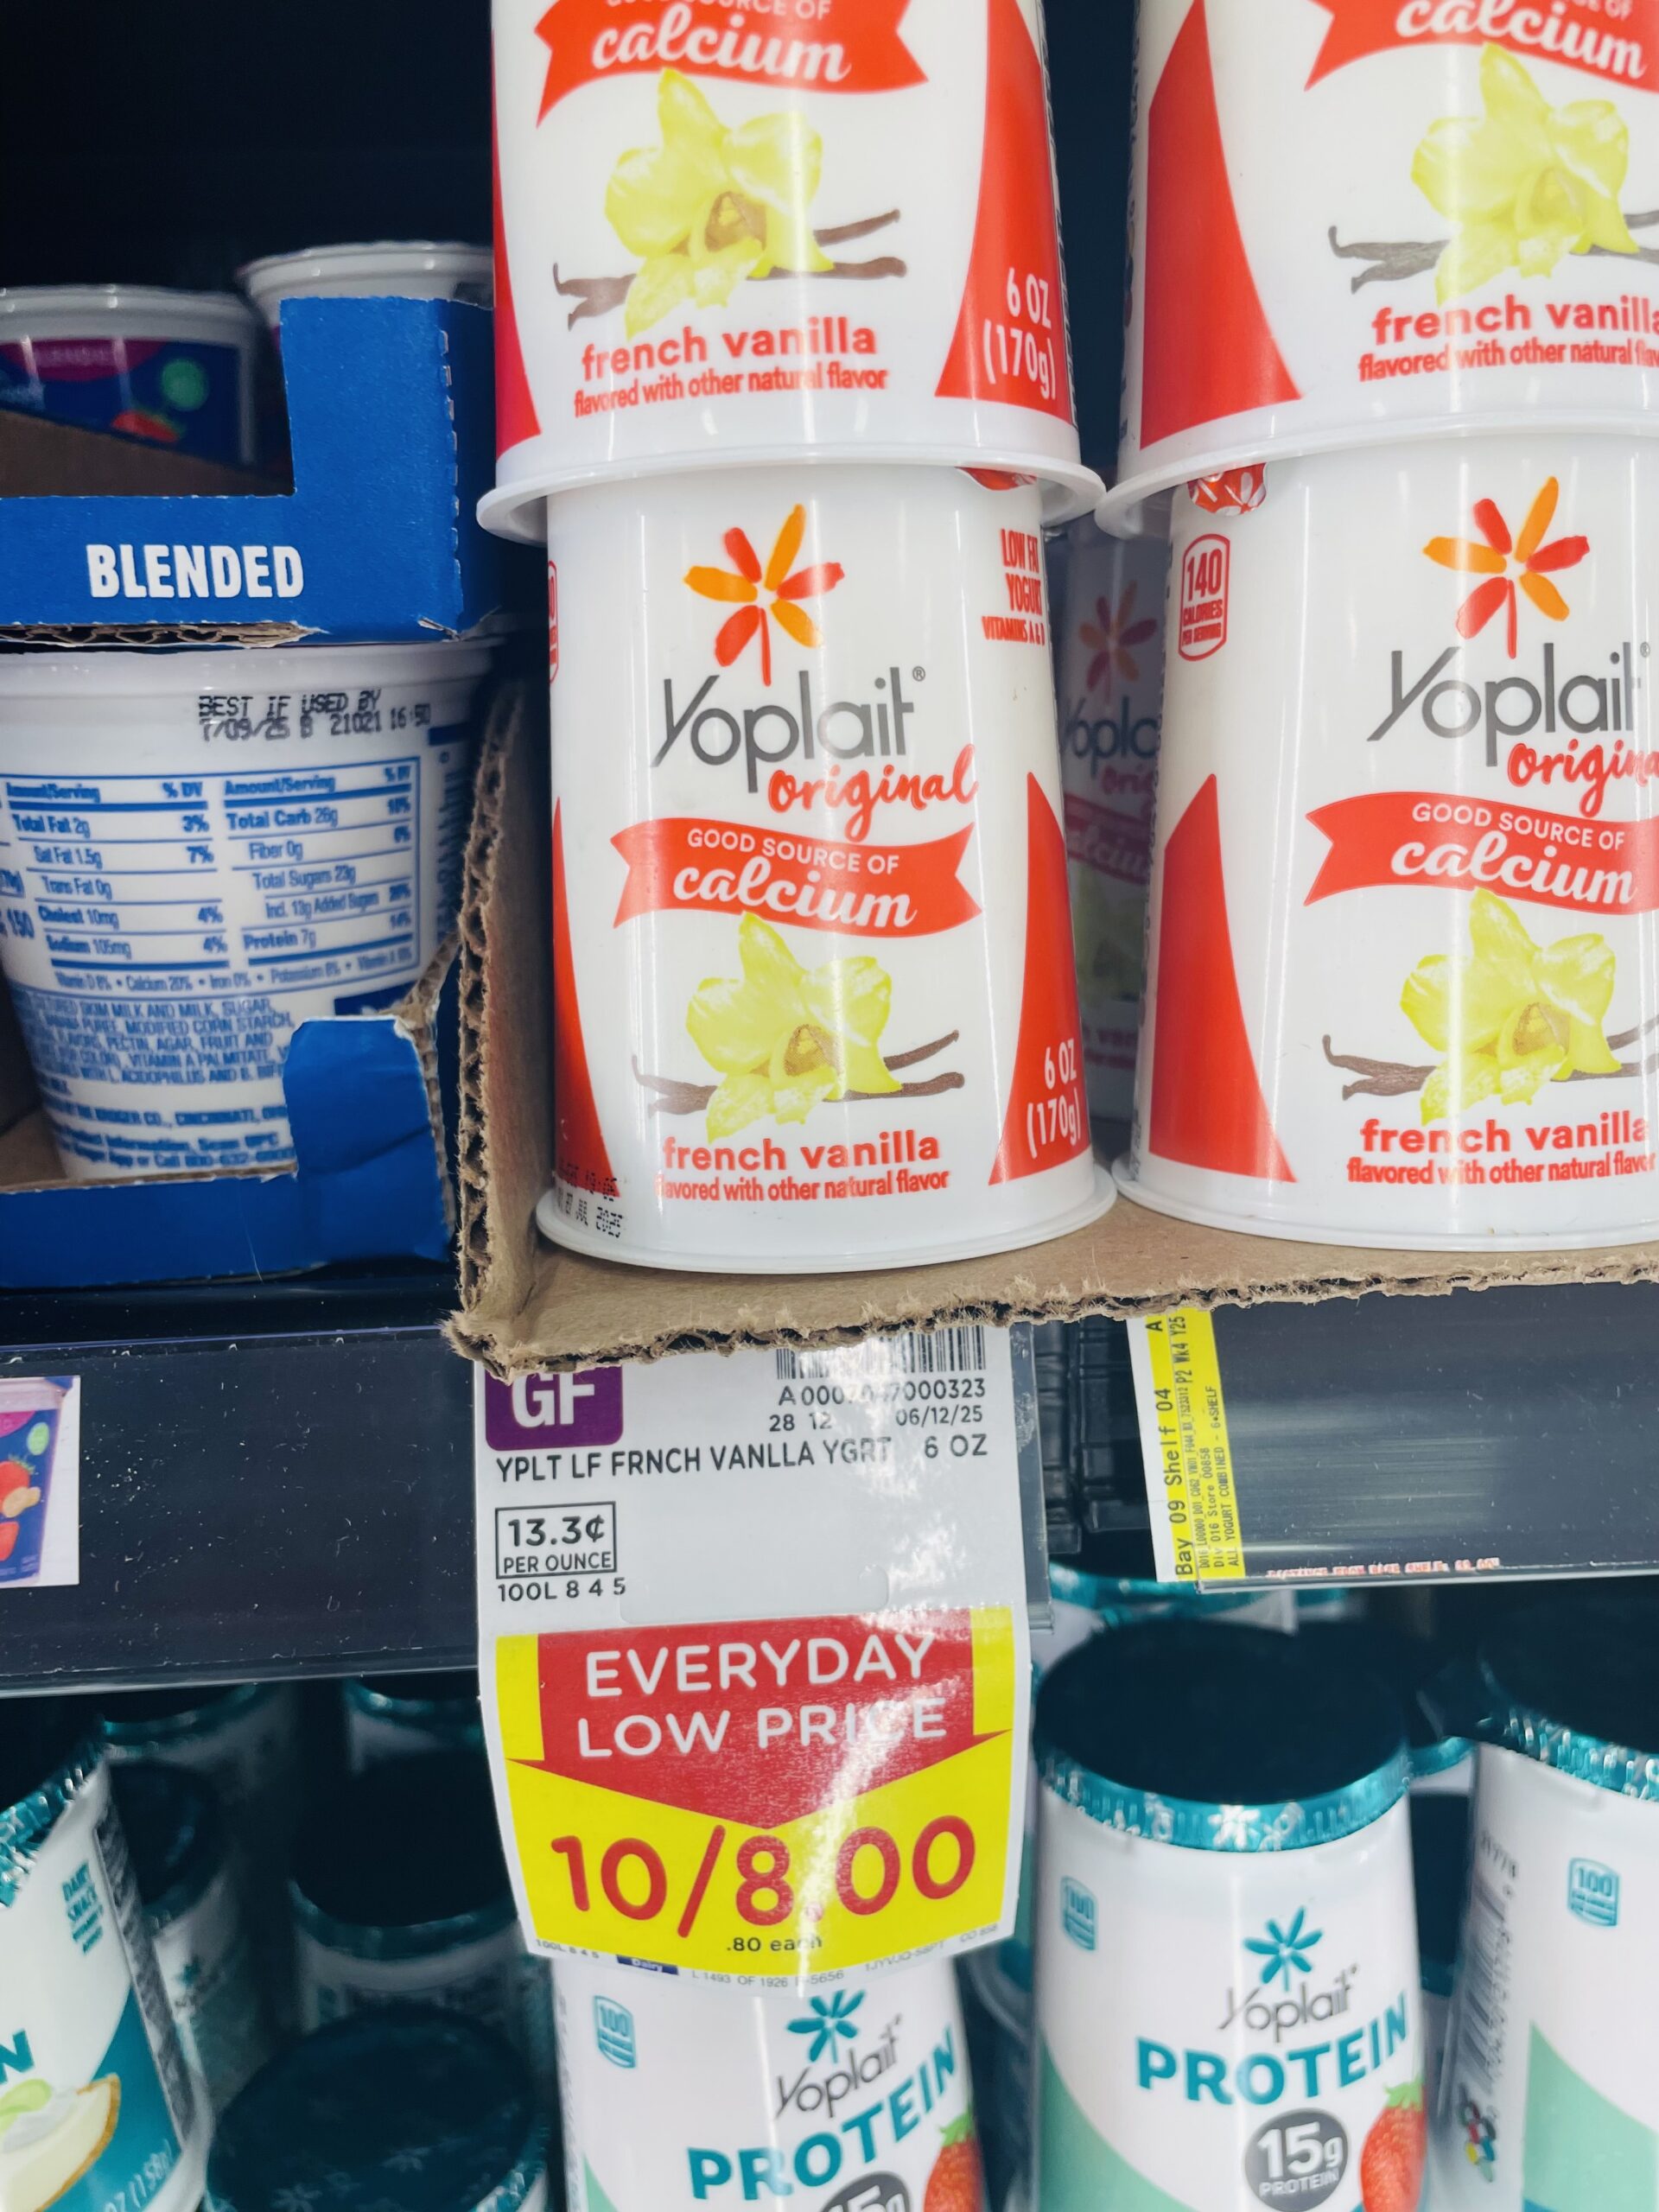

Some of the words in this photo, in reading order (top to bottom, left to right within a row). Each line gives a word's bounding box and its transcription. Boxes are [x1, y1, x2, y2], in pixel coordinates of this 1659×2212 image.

[592, 3, 852, 82] calcium
[1395, 0, 1647, 79] calcium
[1007, 267, 1020, 317] 6
[1026, 273, 1052, 329] OZ
[1371, 294, 1531, 346] french
[582, 326, 708, 382] french
[721, 316, 877, 359] vanilla
[983, 319, 1056, 401] (170g)
[1357, 343, 1450, 382] flavored
[1456, 340, 1505, 369] with
[1510, 336, 1566, 365] other
[1570, 339, 1632, 365] natural
[574, 378, 639, 418] flavored
[642, 373, 685, 405] with
[691, 367, 744, 397] other
[748, 361, 822, 392] natural
[827, 360, 889, 390] flavor
[86, 544, 304, 598] BLENDED
[1001, 528, 1026, 569] LOW
[1187, 549, 1223, 601] 140
[199, 695, 253, 718] BEST
[267, 695, 291, 719] IF
[300, 692, 348, 715] USED
[358, 689, 382, 711] BY
[1367, 641, 1642, 766] Yoplait
[649, 666, 915, 793] Yoplait
[769, 743, 979, 842] original
[1507, 738, 1659, 818] origina
[226, 810, 270, 830] Total
[274, 808, 312, 827] Carb
[1411, 801, 1492, 829] GOOD
[1498, 810, 1593, 849] SOURCE
[1598, 830, 1625, 851] OF
[248, 842, 283, 861] Fiber
[286, 840, 303, 861] 0g
[687, 828, 756, 853] GOOD
[762, 836, 861, 873] SOURCE
[867, 855, 900, 875] OF
[1390, 830, 1638, 906] calcium
[252, 871, 285, 891] Total
[673, 856, 918, 929] calcium
[243, 931, 298, 950] Protein
[1045, 1046, 1056, 1090] 6
[1058, 1038, 1077, 1084] OZ
[1027, 1087, 1081, 1160] (170g)
[1359, 1118, 1511, 1153] french
[1524, 1110, 1649, 1151] vanilla
[663, 1136, 787, 1170] french
[800, 1129, 940, 1170] vanilla
[1347, 1156, 1433, 1184] flavored
[1437, 1156, 1486, 1185] with
[1490, 1158, 1543, 1185] other
[1548, 1152, 1611, 1181] natural
[723, 1176, 764, 1201] with
[768, 1175, 820, 1201] other
[824, 1171, 892, 1198] natural
[898, 1169, 950, 1193] flavor
[1145, 1320, 1163, 1332] A
[1169, 1316, 1186, 1336] Y25
[512, 1372, 595, 1427] GF
[1154, 1389, 1173, 1411] 04
[1175, 1370, 1193, 1383] P2
[769, 1414, 795, 1432] 28
[895, 1405, 983, 1427] 06/12/25
[496, 1455, 560, 1482] YPLT
[572, 1452, 602, 1478] LF
[612, 1446, 701, 1475] FRNCH
[709, 1441, 815, 1471] VANLLA
[823, 1436, 892, 1465] YGRT
[924, 1435, 939, 1459] 6
[950, 1433, 988, 1458] OZ
[1159, 1424, 1182, 1485] Shelf
[1213, 1446, 1229, 1497] COMBINED
[1167, 1500, 1186, 1523] 09
[1207, 1484, 1217, 1516] Store
[1221, 1503, 1235, 1541] YOGURT
[508, 1514, 605, 1547] 13.3¢
[1210, 1522, 1221, 1541] 016
[504, 1555, 539, 1573] PER
[545, 1551, 612, 1571] OUNCE
[1175, 1537, 1194, 1575] Bay
[498, 1581, 558, 1602] 100L
[566, 1580, 580, 1599] 8
[588, 1579, 603, 1597] 4
[613, 1577, 626, 1595] 5
[586, 1633, 936, 1697] EVERYDAY
[578, 1709, 731, 1758] LOW
[757, 1696, 948, 1750] PRICE
[551, 1815, 976, 1938] 10/8.00
[632, 1958, 664, 1972] Dairy
[727, 1936, 761, 1952] .80
[703, 1972, 731, 1984] 1493
[738, 1976, 755, 1986] OF
[761, 1977, 788, 1987] 1926
[1217, 1969, 1351, 2044] Yoplait
[775, 2024, 900, 2120] Yoplait
[1135, 1991, 1408, 2106] PROTEIN
[687, 2023, 960, 2202] PROTEIN
[1257, 2121, 1344, 2178] 15g
[1259, 2167, 1340, 2196] PROTEIN
